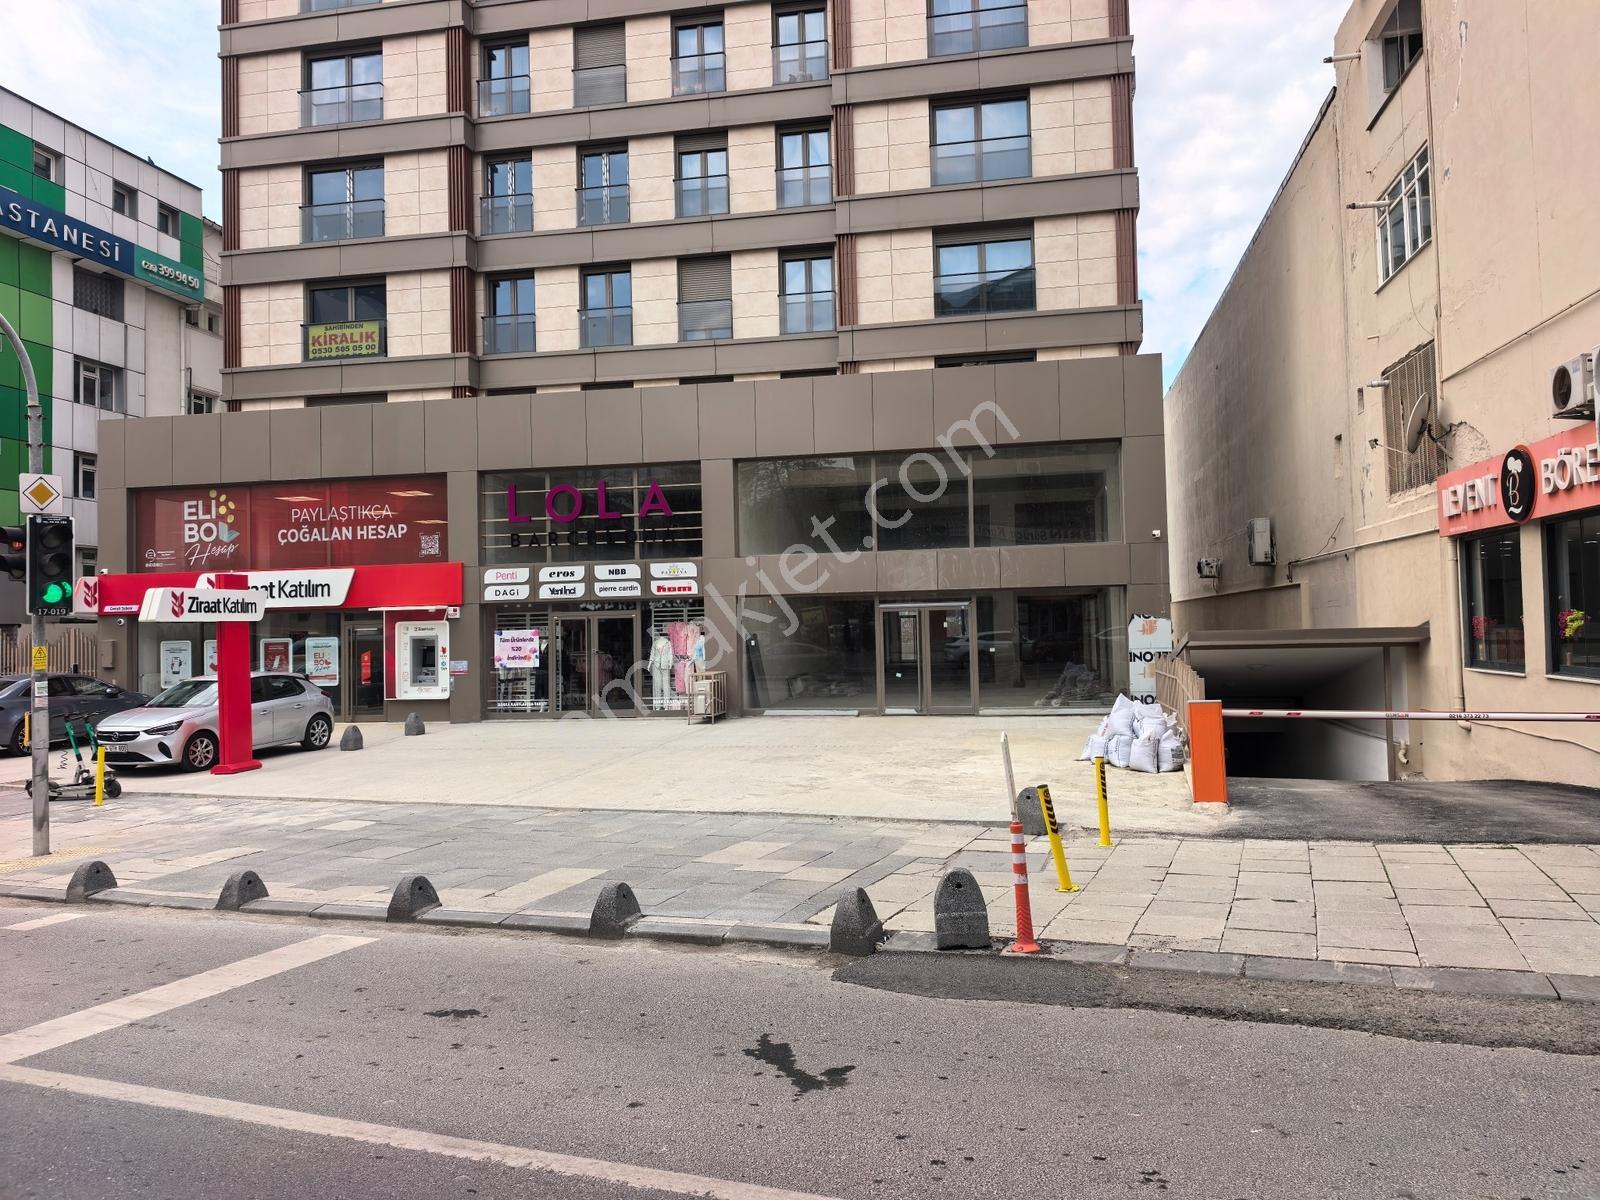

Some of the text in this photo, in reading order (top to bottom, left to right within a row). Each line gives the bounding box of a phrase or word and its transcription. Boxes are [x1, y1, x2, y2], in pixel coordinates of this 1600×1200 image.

[0, 202, 120, 262] STANESİ
[158, 264, 175, 278] 399
[175, 271, 188, 285] 94
[188, 276, 200, 289] 50
[311, 331, 377, 348] KİRALIK
[365, 343, 377, 351] 00
[506, 478, 674, 524] LOLA
[291, 504, 393, 523] PAYLAŞTIKÇA
[277, 523, 408, 546] ÇOĞALAN HESAP
[184, 543, 240, 567] Hesap
[495, 571, 518, 581] Penti
[548, 570, 576, 578] eros
[608, 568, 627, 576] NBB
[278, 579, 331, 598] Katılım
[598, 583, 639, 593] pierre cardin
[37, 608, 67, 616] 17-019
[187, 595, 257, 614] Ziraat Katılım
